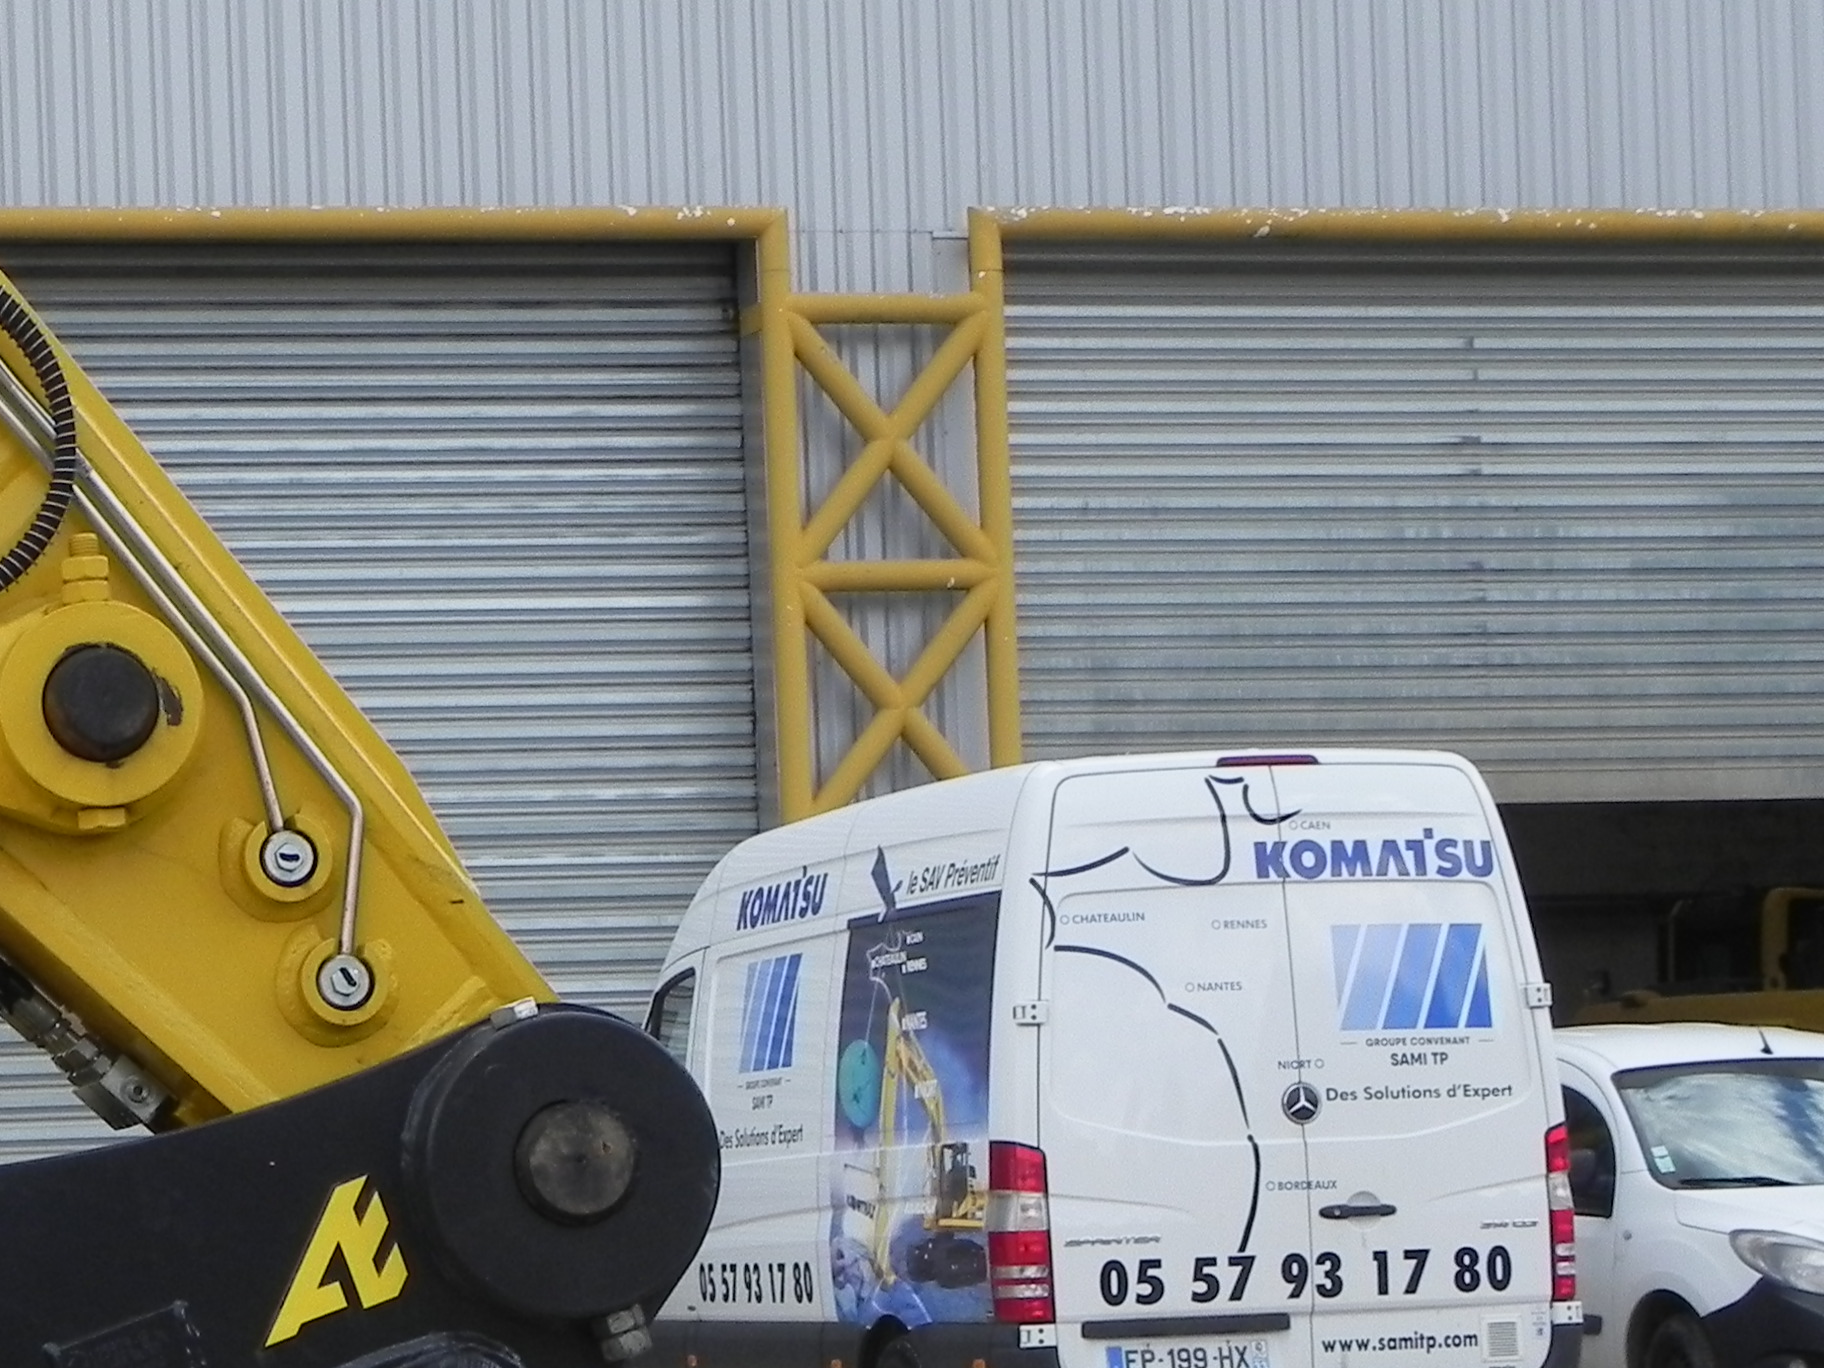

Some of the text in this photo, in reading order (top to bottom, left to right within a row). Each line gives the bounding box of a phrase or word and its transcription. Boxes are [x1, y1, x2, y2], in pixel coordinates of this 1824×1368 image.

[1300, 820, 1331, 831] CAEN
[1253, 828, 1494, 879] KOMATSU
[919, 864, 946, 893] SAV
[944, 854, 1001, 888] Préventif
[736, 865, 829, 931] KOMATSU
[1072, 912, 1145, 925] CHATEAULIN
[1223, 919, 1268, 930] RENNES
[1197, 981, 1243, 992] NANTES
[1365, 1037, 1407, 1047] GROUPE
[1390, 1051, 1449, 1066] SAMI TP
[1326, 1087, 1358, 1101] Des
[1364, 1084, 1441, 1101] Solutions
[1278, 1180, 1337, 1191] BORDEAUX
[699, 1261, 814, 1304] 05 57 93 17 80
[1100, 1245, 1512, 1307] 05 57 93 17 80
[1322, 1330, 1479, 1354] www.samitp.com
